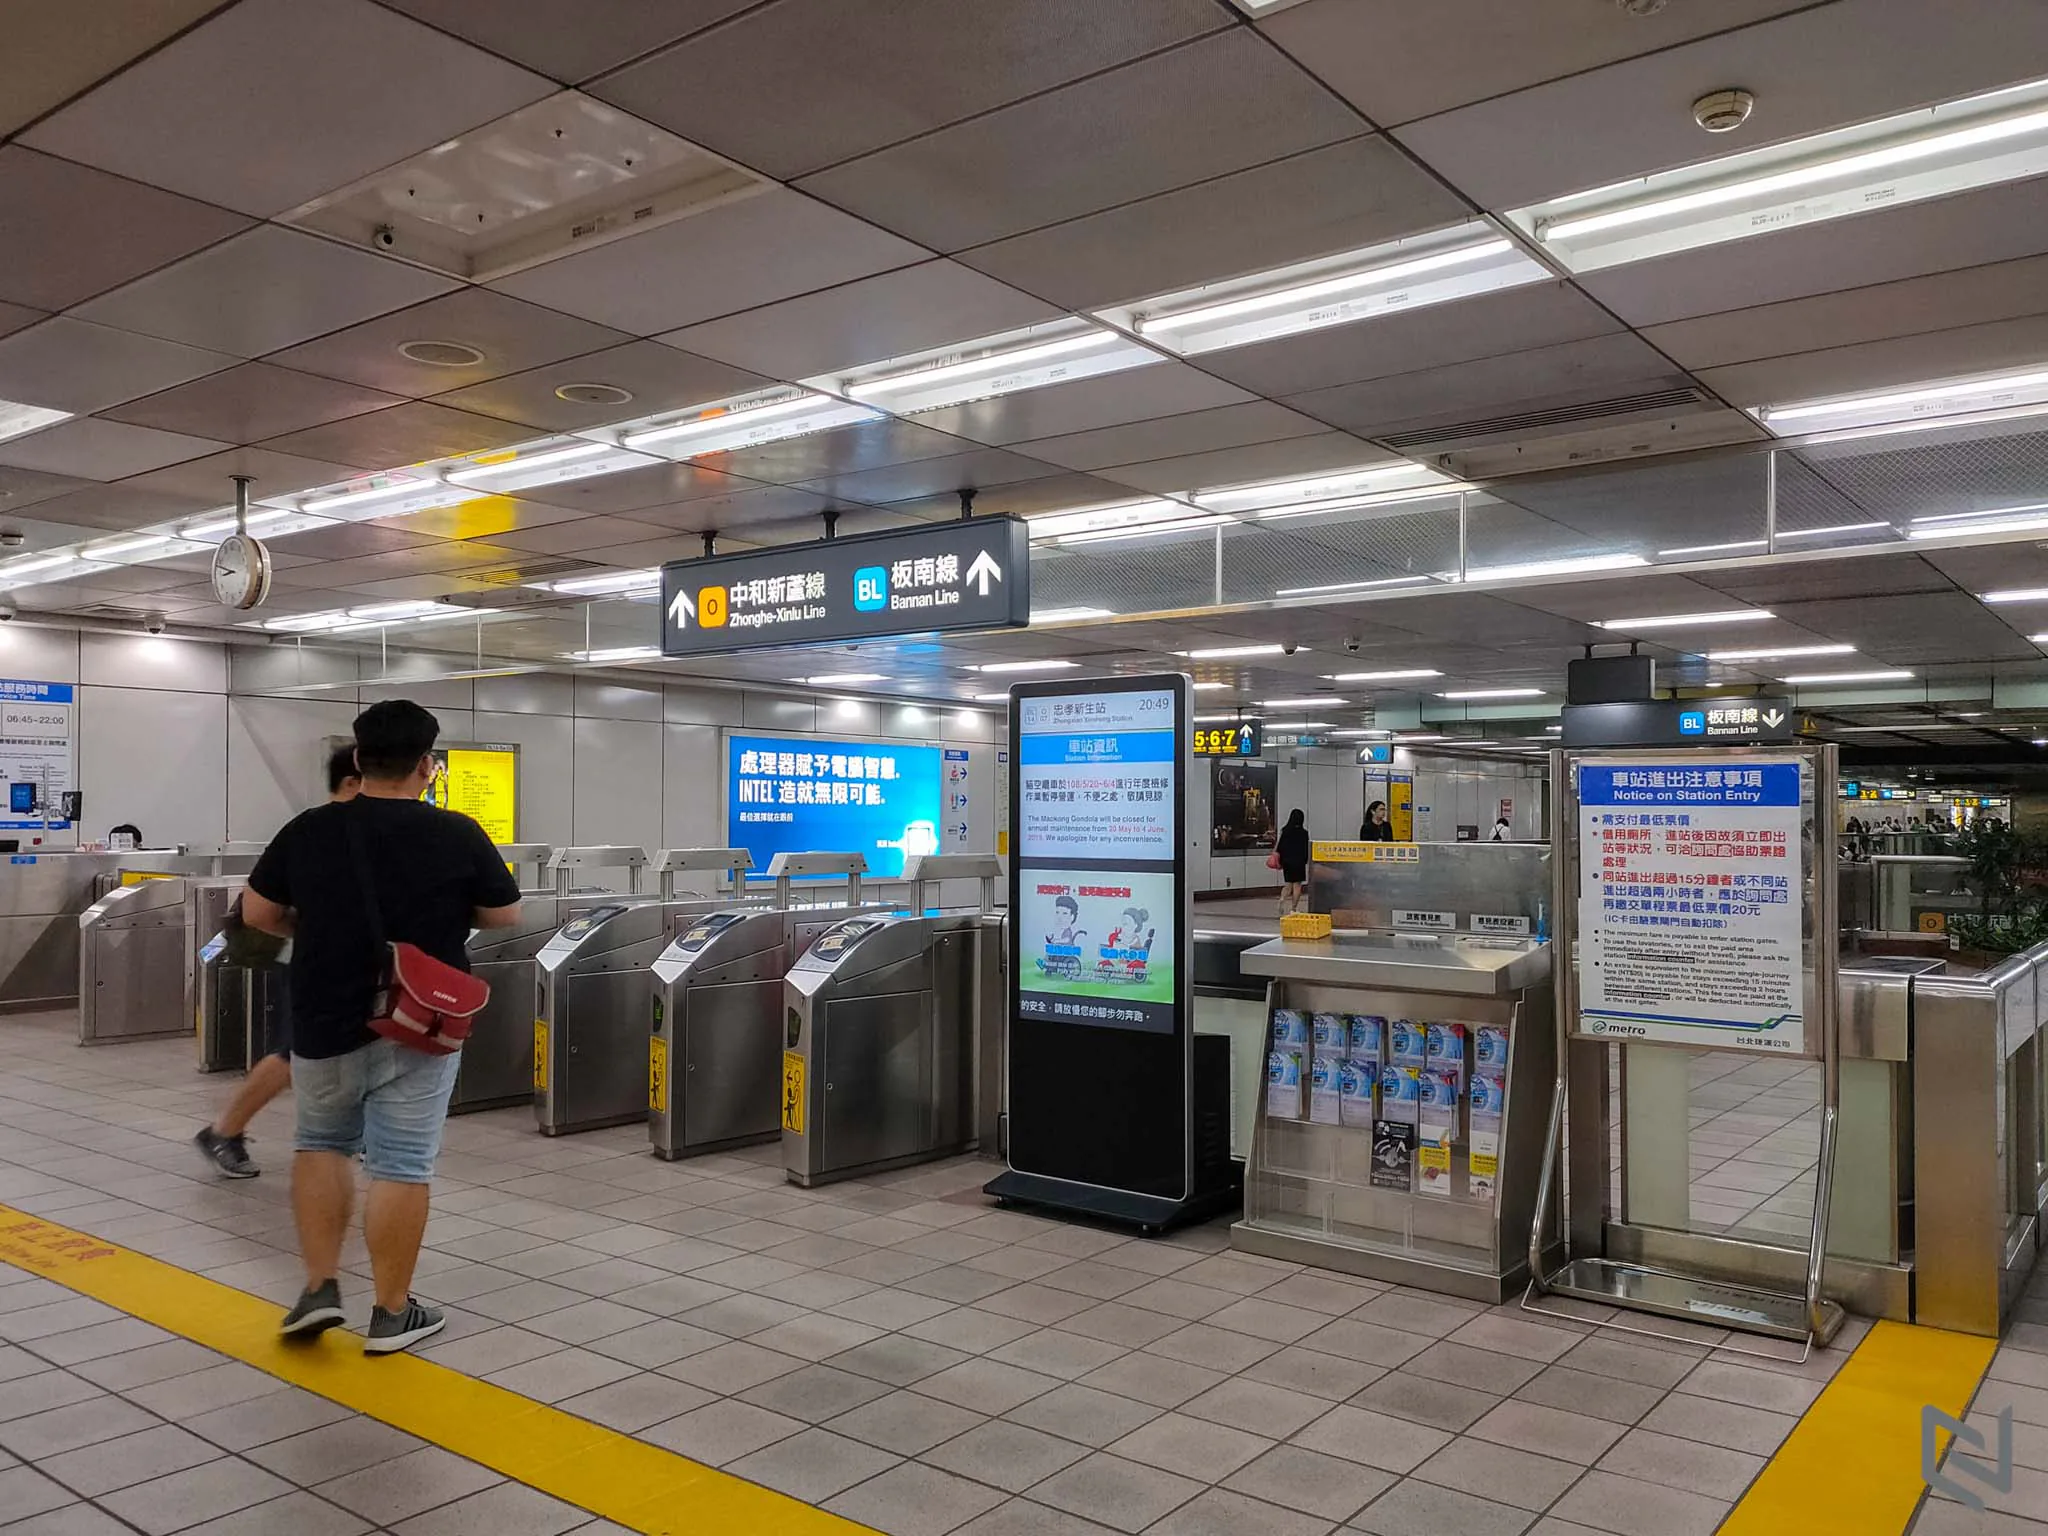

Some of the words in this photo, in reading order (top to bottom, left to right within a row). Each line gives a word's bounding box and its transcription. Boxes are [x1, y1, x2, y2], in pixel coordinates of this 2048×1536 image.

[891, 553, 959, 589] 板南線
[730, 571, 826, 608] 中和新蘆線
[858, 579, 882, 601] BL
[707, 598, 718, 616] O
[891, 593, 933, 609] Bannan
[935, 588, 960, 605] Line
[729, 608, 801, 628] Zhonghe-Xinlu
[803, 604, 826, 620] Line
[1053, 702, 1106, 716] 忠孝新生站
[1139, 697, 1169, 711] 20:49
[1683, 718, 1701, 729] BL
[1707, 708, 1759, 724] 板南線
[1707, 727, 1739, 735] Bannan
[1740, 725, 1759, 735] Line
[1068, 737, 1118, 754] 車站資訊
[739, 749, 900, 780] 處理器賦予電腦智慧。
[1612, 770, 1762, 788] 車站進出注意事項
[778, 781, 886, 806] 造就無限可能。
[1613, 790, 1654, 801] Notice
[1657, 792, 1673, 801] on
[1676, 790, 1722, 801] Station
[1725, 790, 1761, 802] Entry
[1112, 815, 1121, 823] be
[1122, 815, 1144, 823] closed
[1146, 815, 1156, 823] for
[1089, 834, 1098, 842] for
[1602, 871, 1788, 888] 同站進出超過15分鐘者或不同站
[1603, 898, 1761, 916] 再繳交單程票最低票價20元
[1720, 984, 1757, 992] exceeding
[1608, 1024, 1646, 1036] metro
